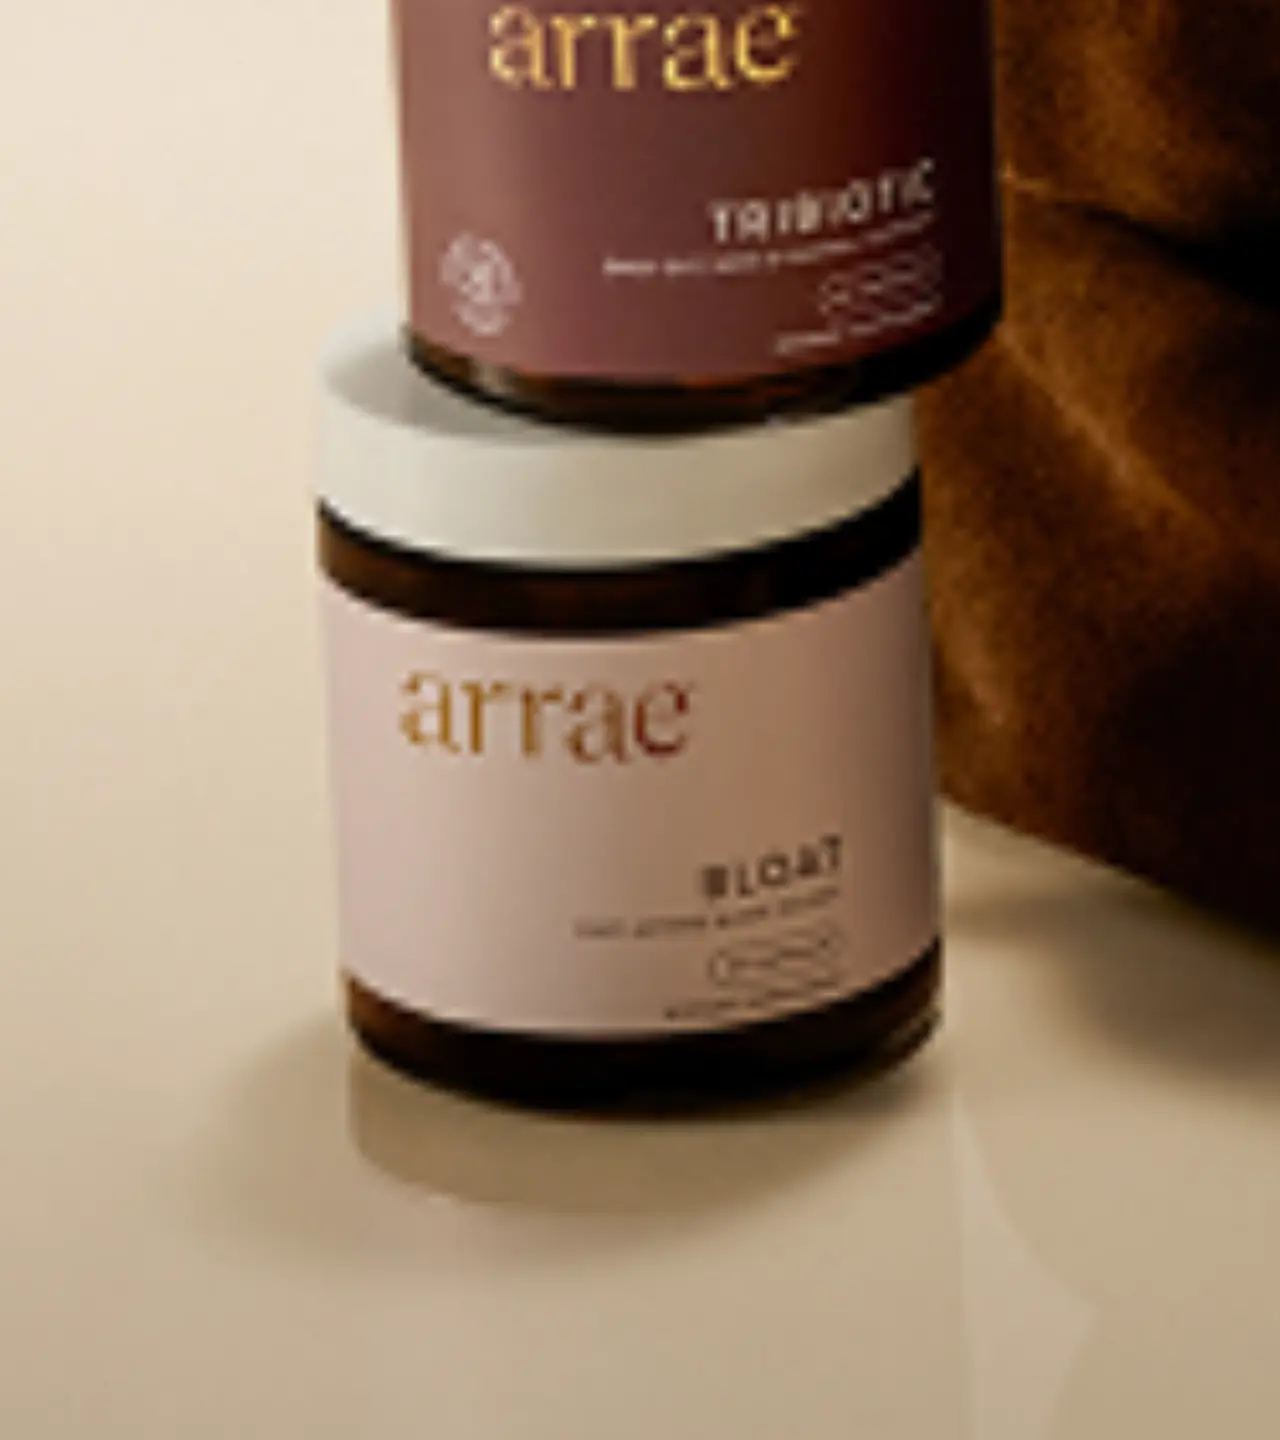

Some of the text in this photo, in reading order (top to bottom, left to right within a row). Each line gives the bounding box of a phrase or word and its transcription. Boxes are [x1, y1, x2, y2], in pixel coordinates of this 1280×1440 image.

[487, 2, 803, 91] arrae
[398, 670, 692, 765] arrae
[701, 831, 844, 901] BLOAT
